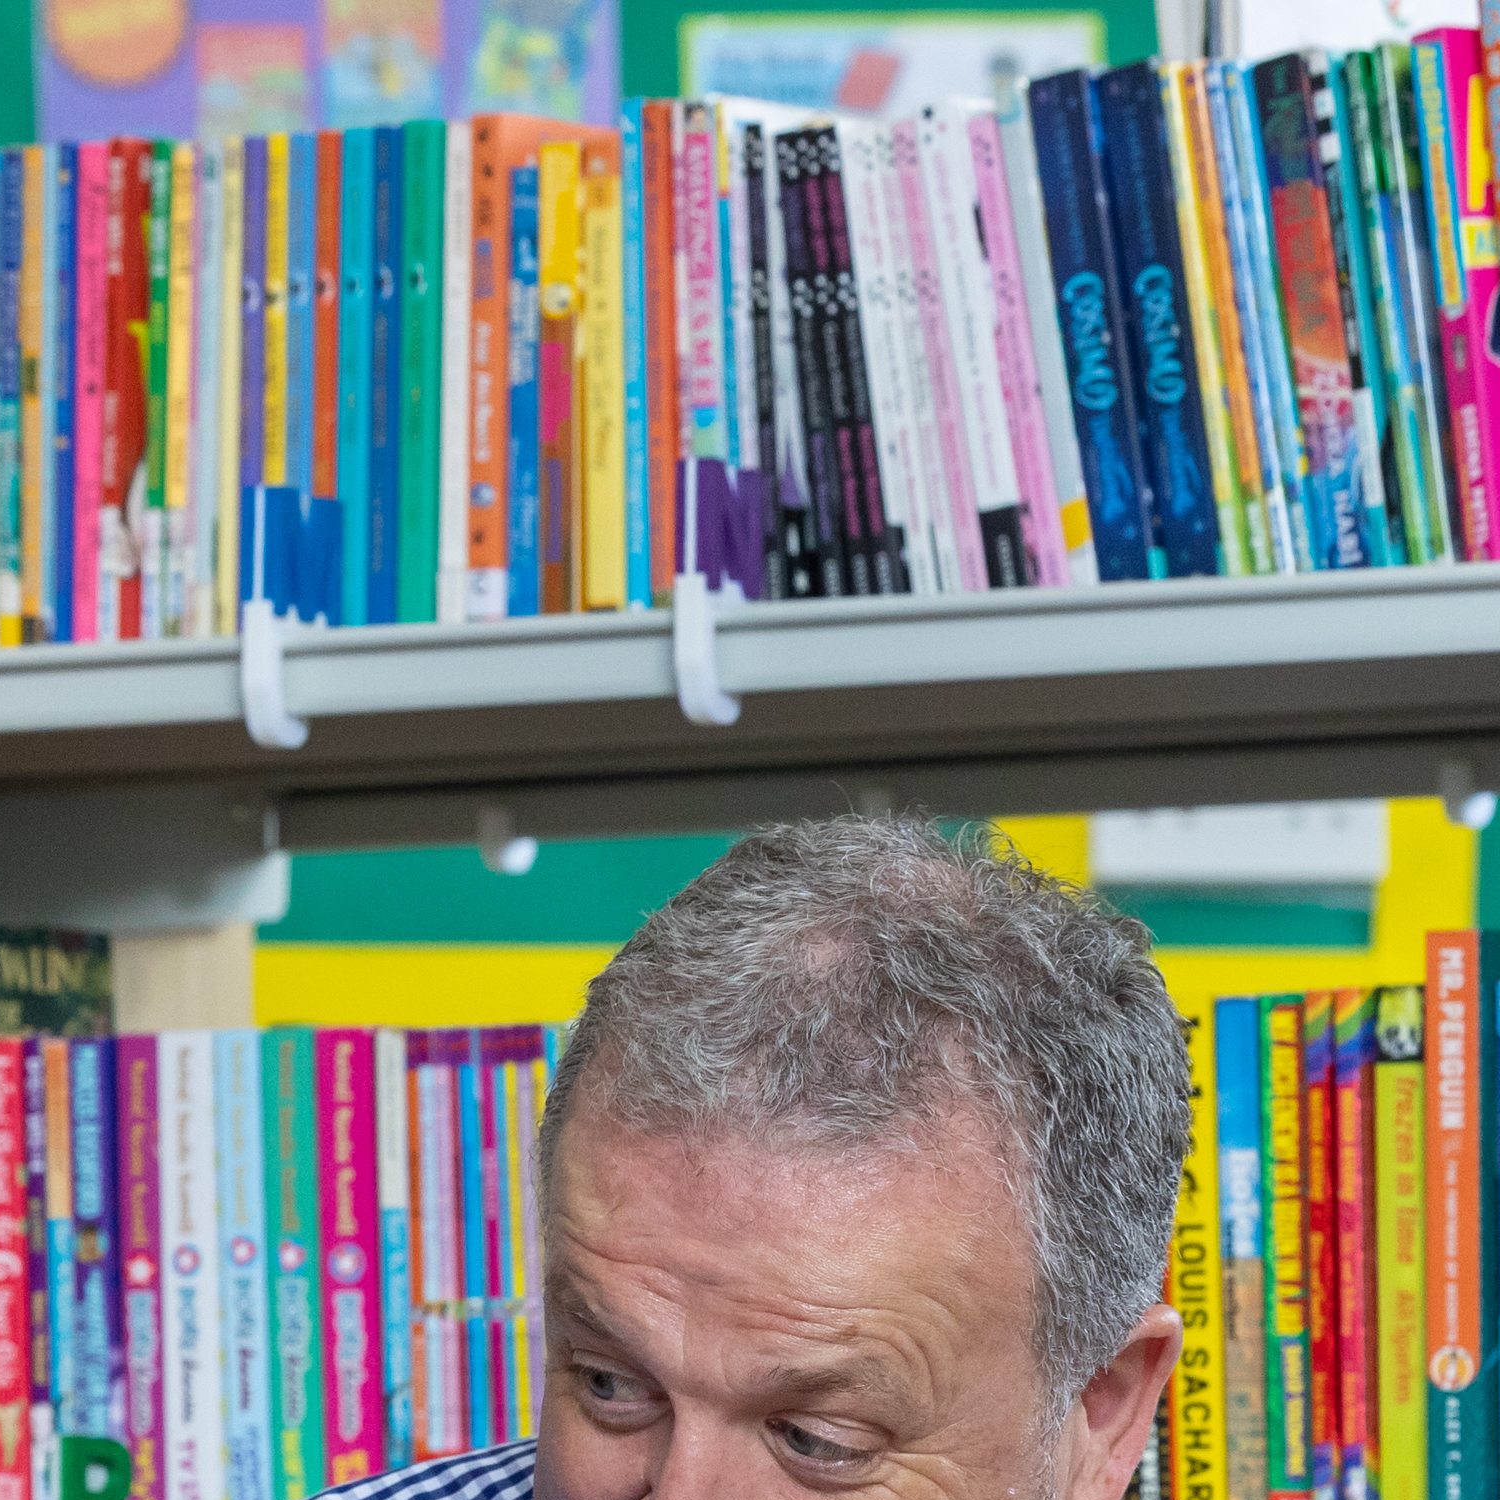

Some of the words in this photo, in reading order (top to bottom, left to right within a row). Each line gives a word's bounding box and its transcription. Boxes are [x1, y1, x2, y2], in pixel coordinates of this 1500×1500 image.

[1437, 946, 1466, 1000] MR.
[1437, 1001, 1466, 1130] PENGUIN
[1395, 1075, 1418, 1165] frozen
[1228, 1149, 1262, 1259] holes
[1395, 1205, 1418, 1266] time
[1176, 1223, 1209, 1331] LOUIS
